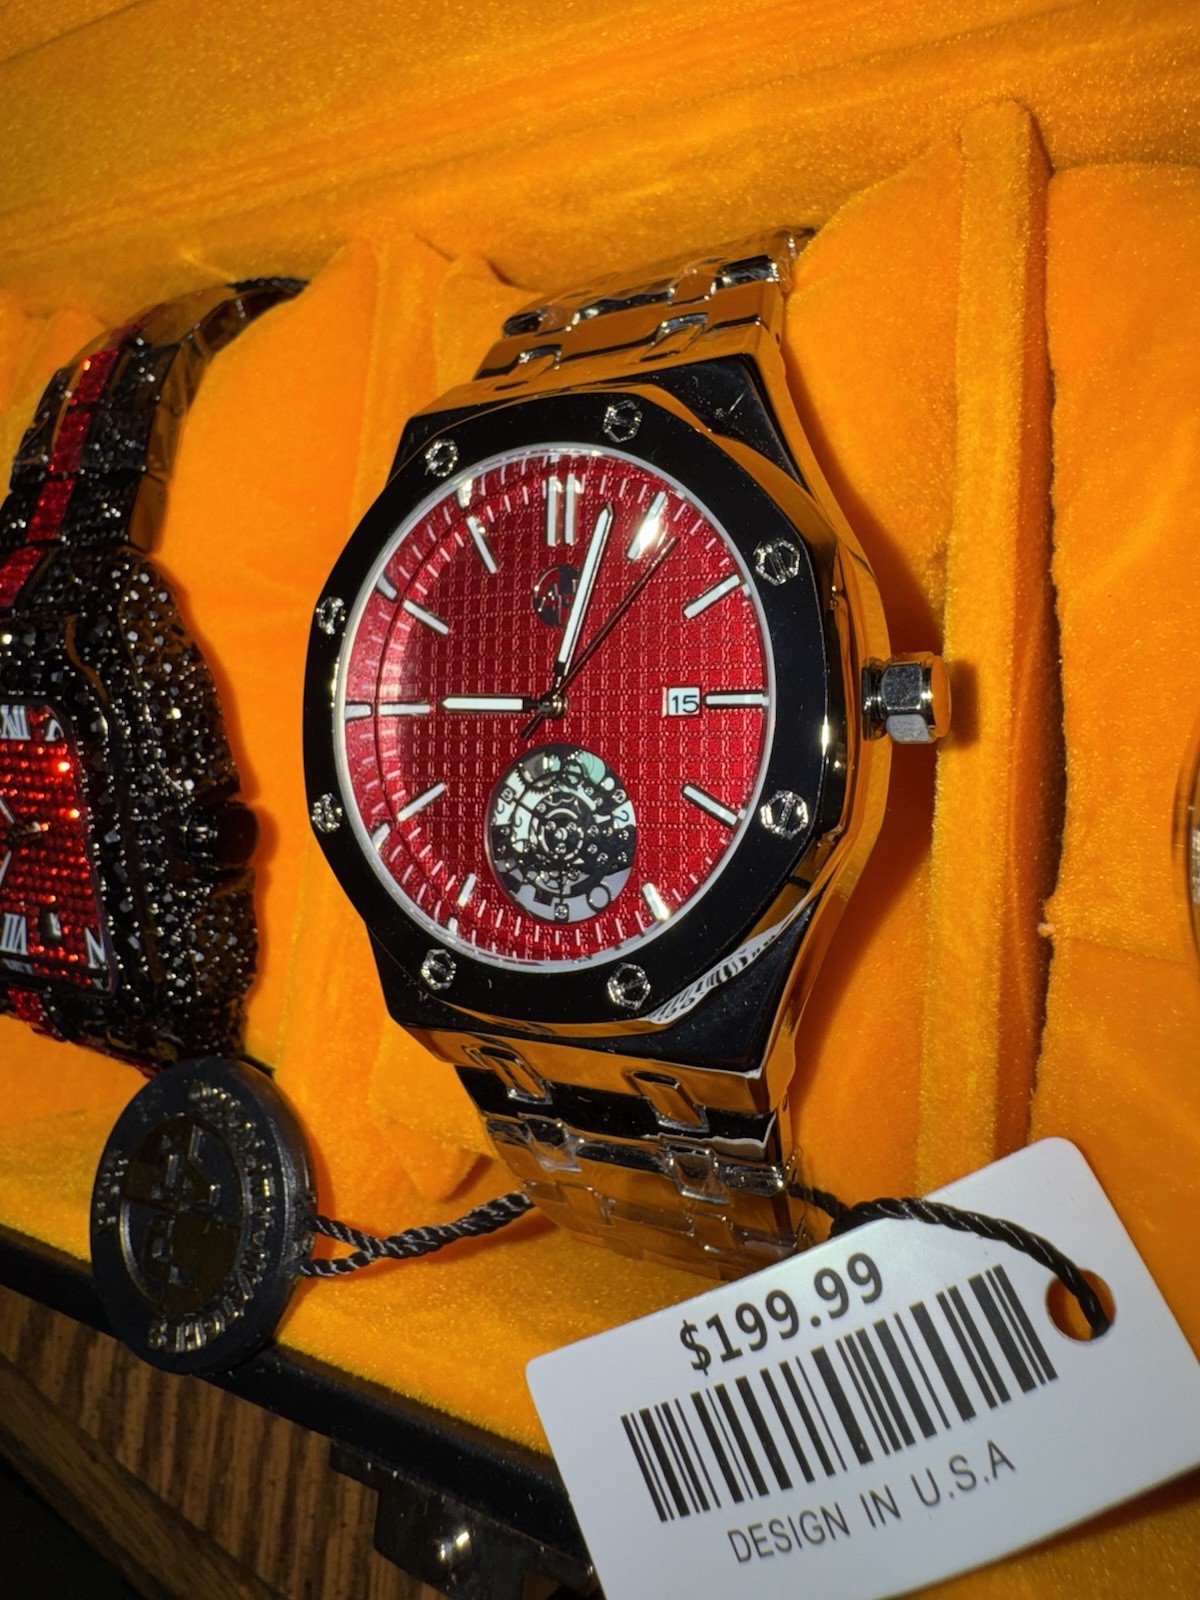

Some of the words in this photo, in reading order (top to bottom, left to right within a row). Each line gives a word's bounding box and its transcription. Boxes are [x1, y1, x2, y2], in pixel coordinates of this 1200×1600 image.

[671, 694, 699, 714] 15
[679, 1252, 883, 1377] $199.99
[727, 1501, 851, 1564] DESIGN
[859, 1483, 901, 1528] IN
[909, 1439, 1016, 1507] U.S.A
